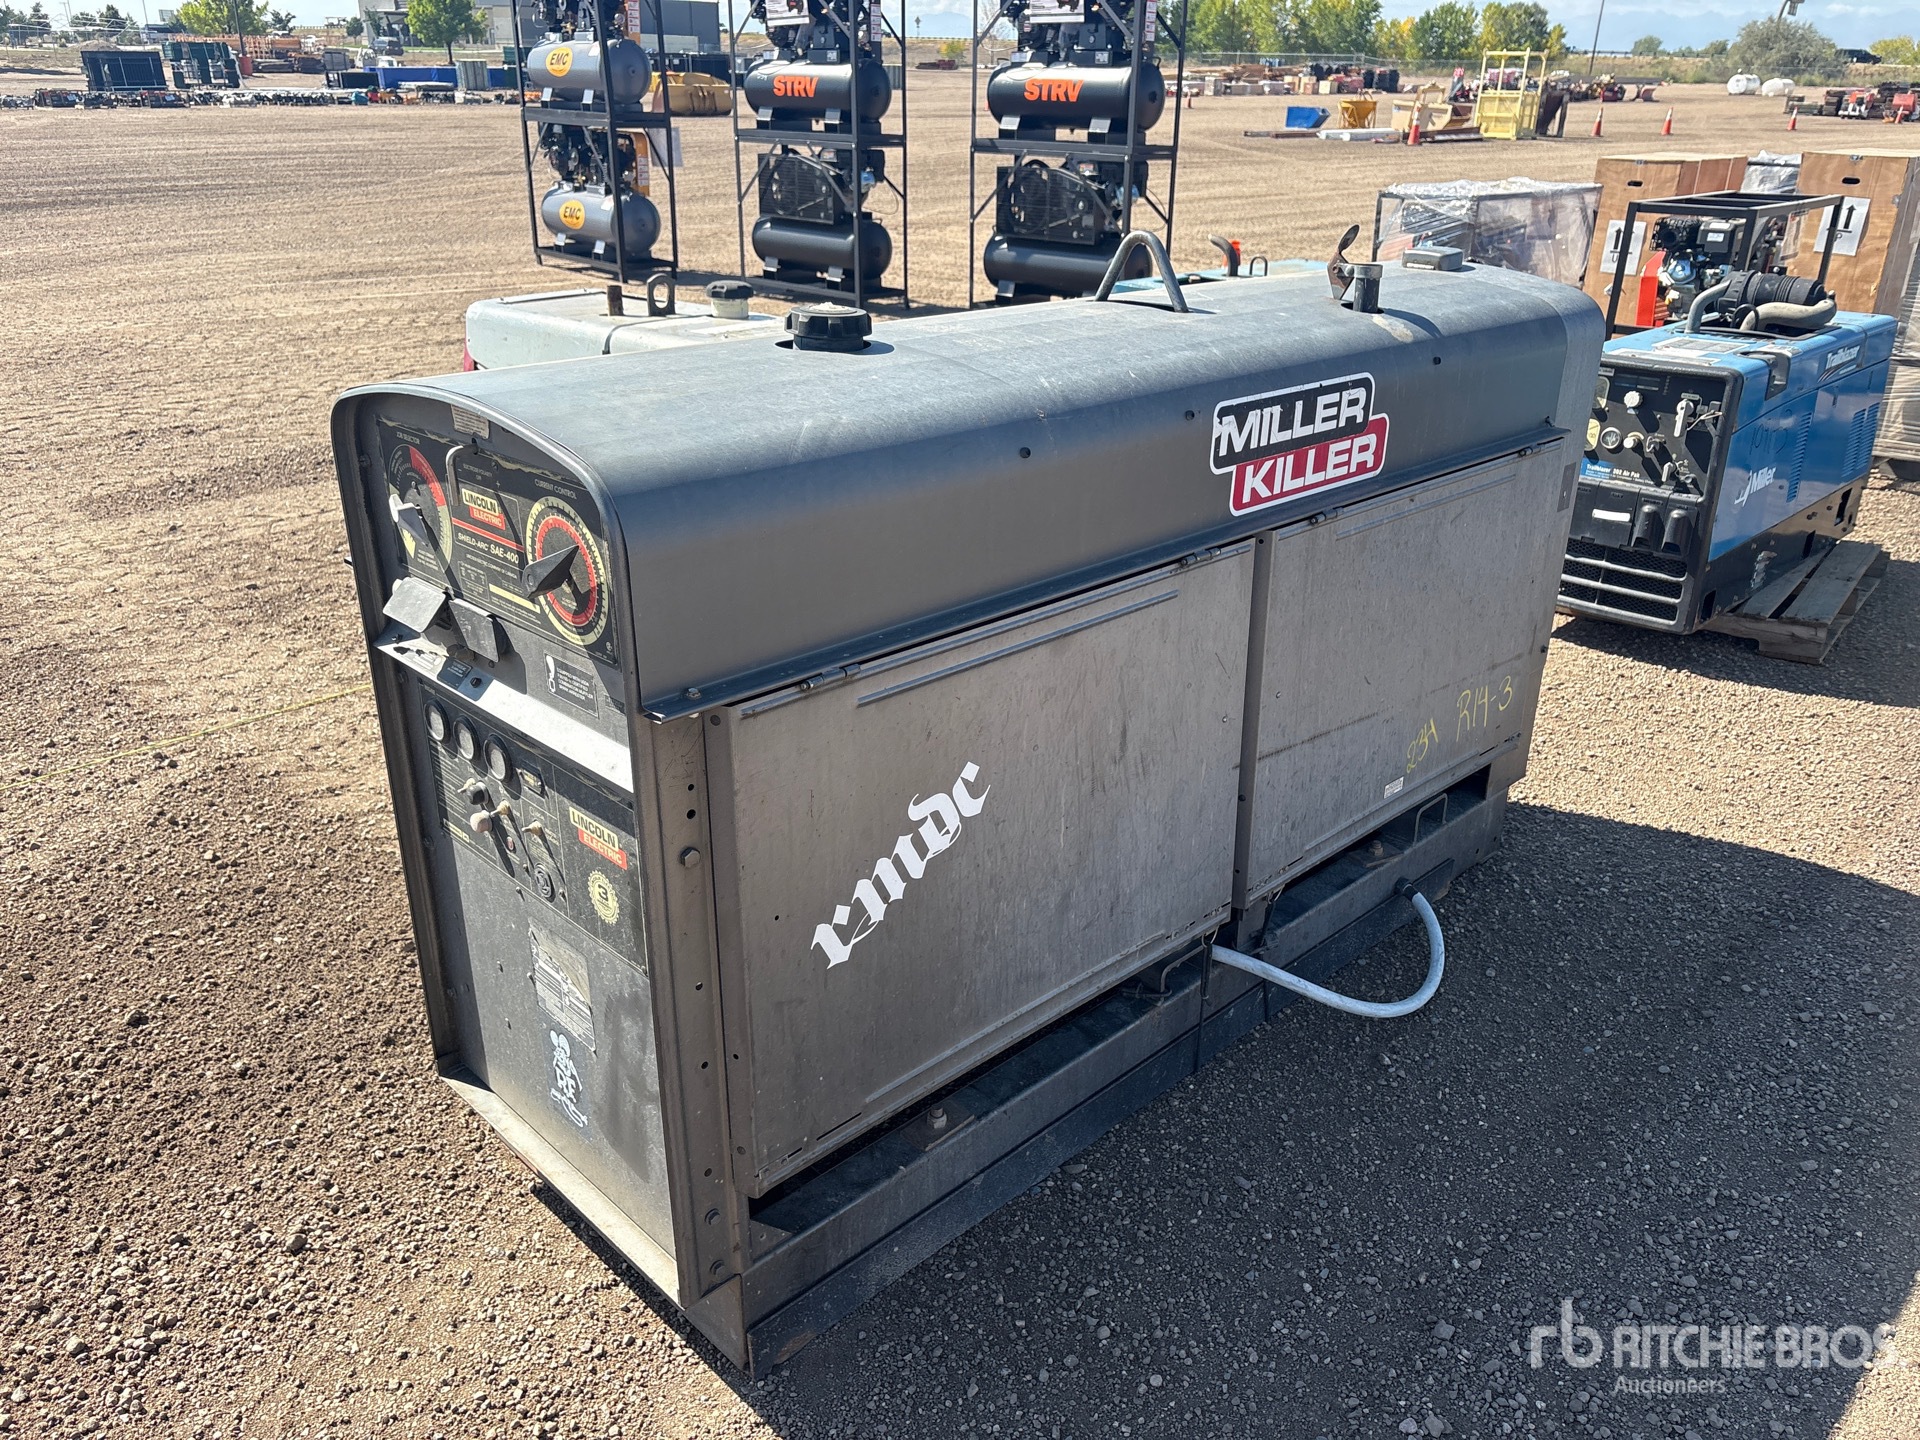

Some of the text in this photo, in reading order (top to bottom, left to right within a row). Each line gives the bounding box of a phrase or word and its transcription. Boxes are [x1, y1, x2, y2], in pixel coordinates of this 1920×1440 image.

[549, 53, 569, 67] EMC
[773, 76, 819, 98] STRV
[1023, 79, 1084, 103] STRV
[563, 207, 581, 221] EMC
[1218, 386, 1367, 457] MILLER
[1242, 433, 1377, 504] KILLER
[1750, 466, 1777, 494] Miller
[463, 490, 497, 514] LINCOLN
[473, 511, 503, 528] ELECTRIC
[490, 543, 519, 564] SAE-400
[1406, 675, 1513, 774] 234 R14-3
[572, 810, 616, 849] LINCOLN
[583, 832, 623, 864] ELECTRIC
[597, 883, 609, 902] 3
